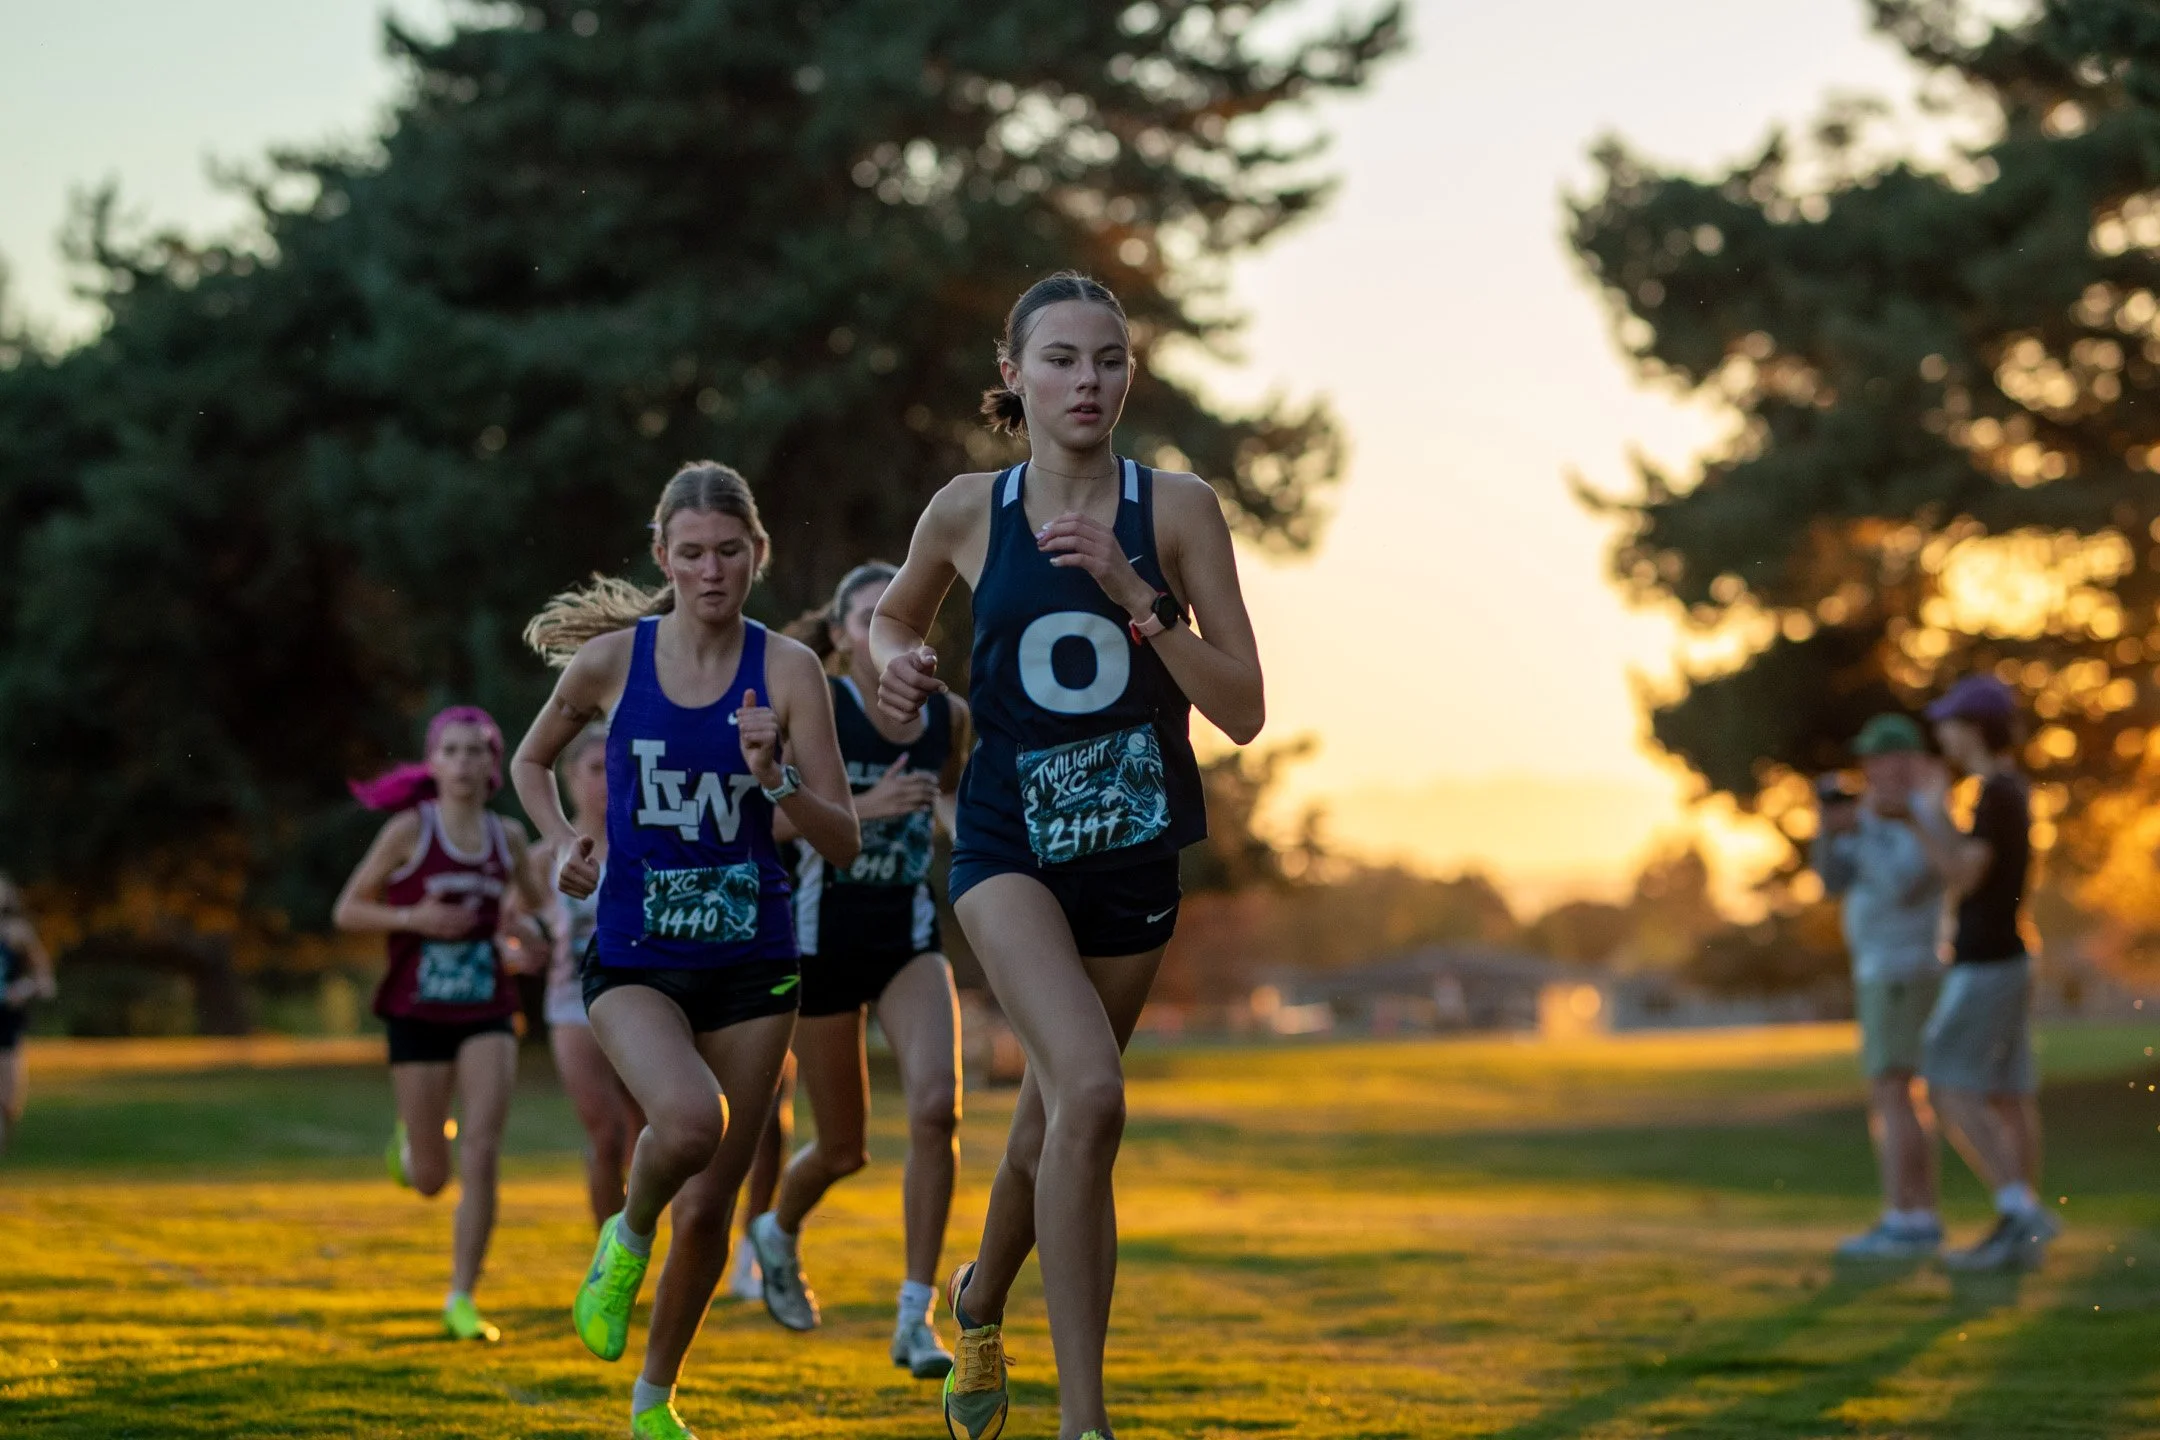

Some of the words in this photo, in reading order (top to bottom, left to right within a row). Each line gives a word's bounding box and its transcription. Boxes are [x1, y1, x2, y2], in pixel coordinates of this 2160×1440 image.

[1018, 611, 1130, 714] O
[1031, 739, 1112, 793] TWILIGHT
[632, 738, 760, 843] LW
[1052, 770, 1089, 804] XC
[1055, 786, 1099, 810] INVITATIONAL
[667, 873, 699, 897] XC
[658, 907, 719, 938] 1440
